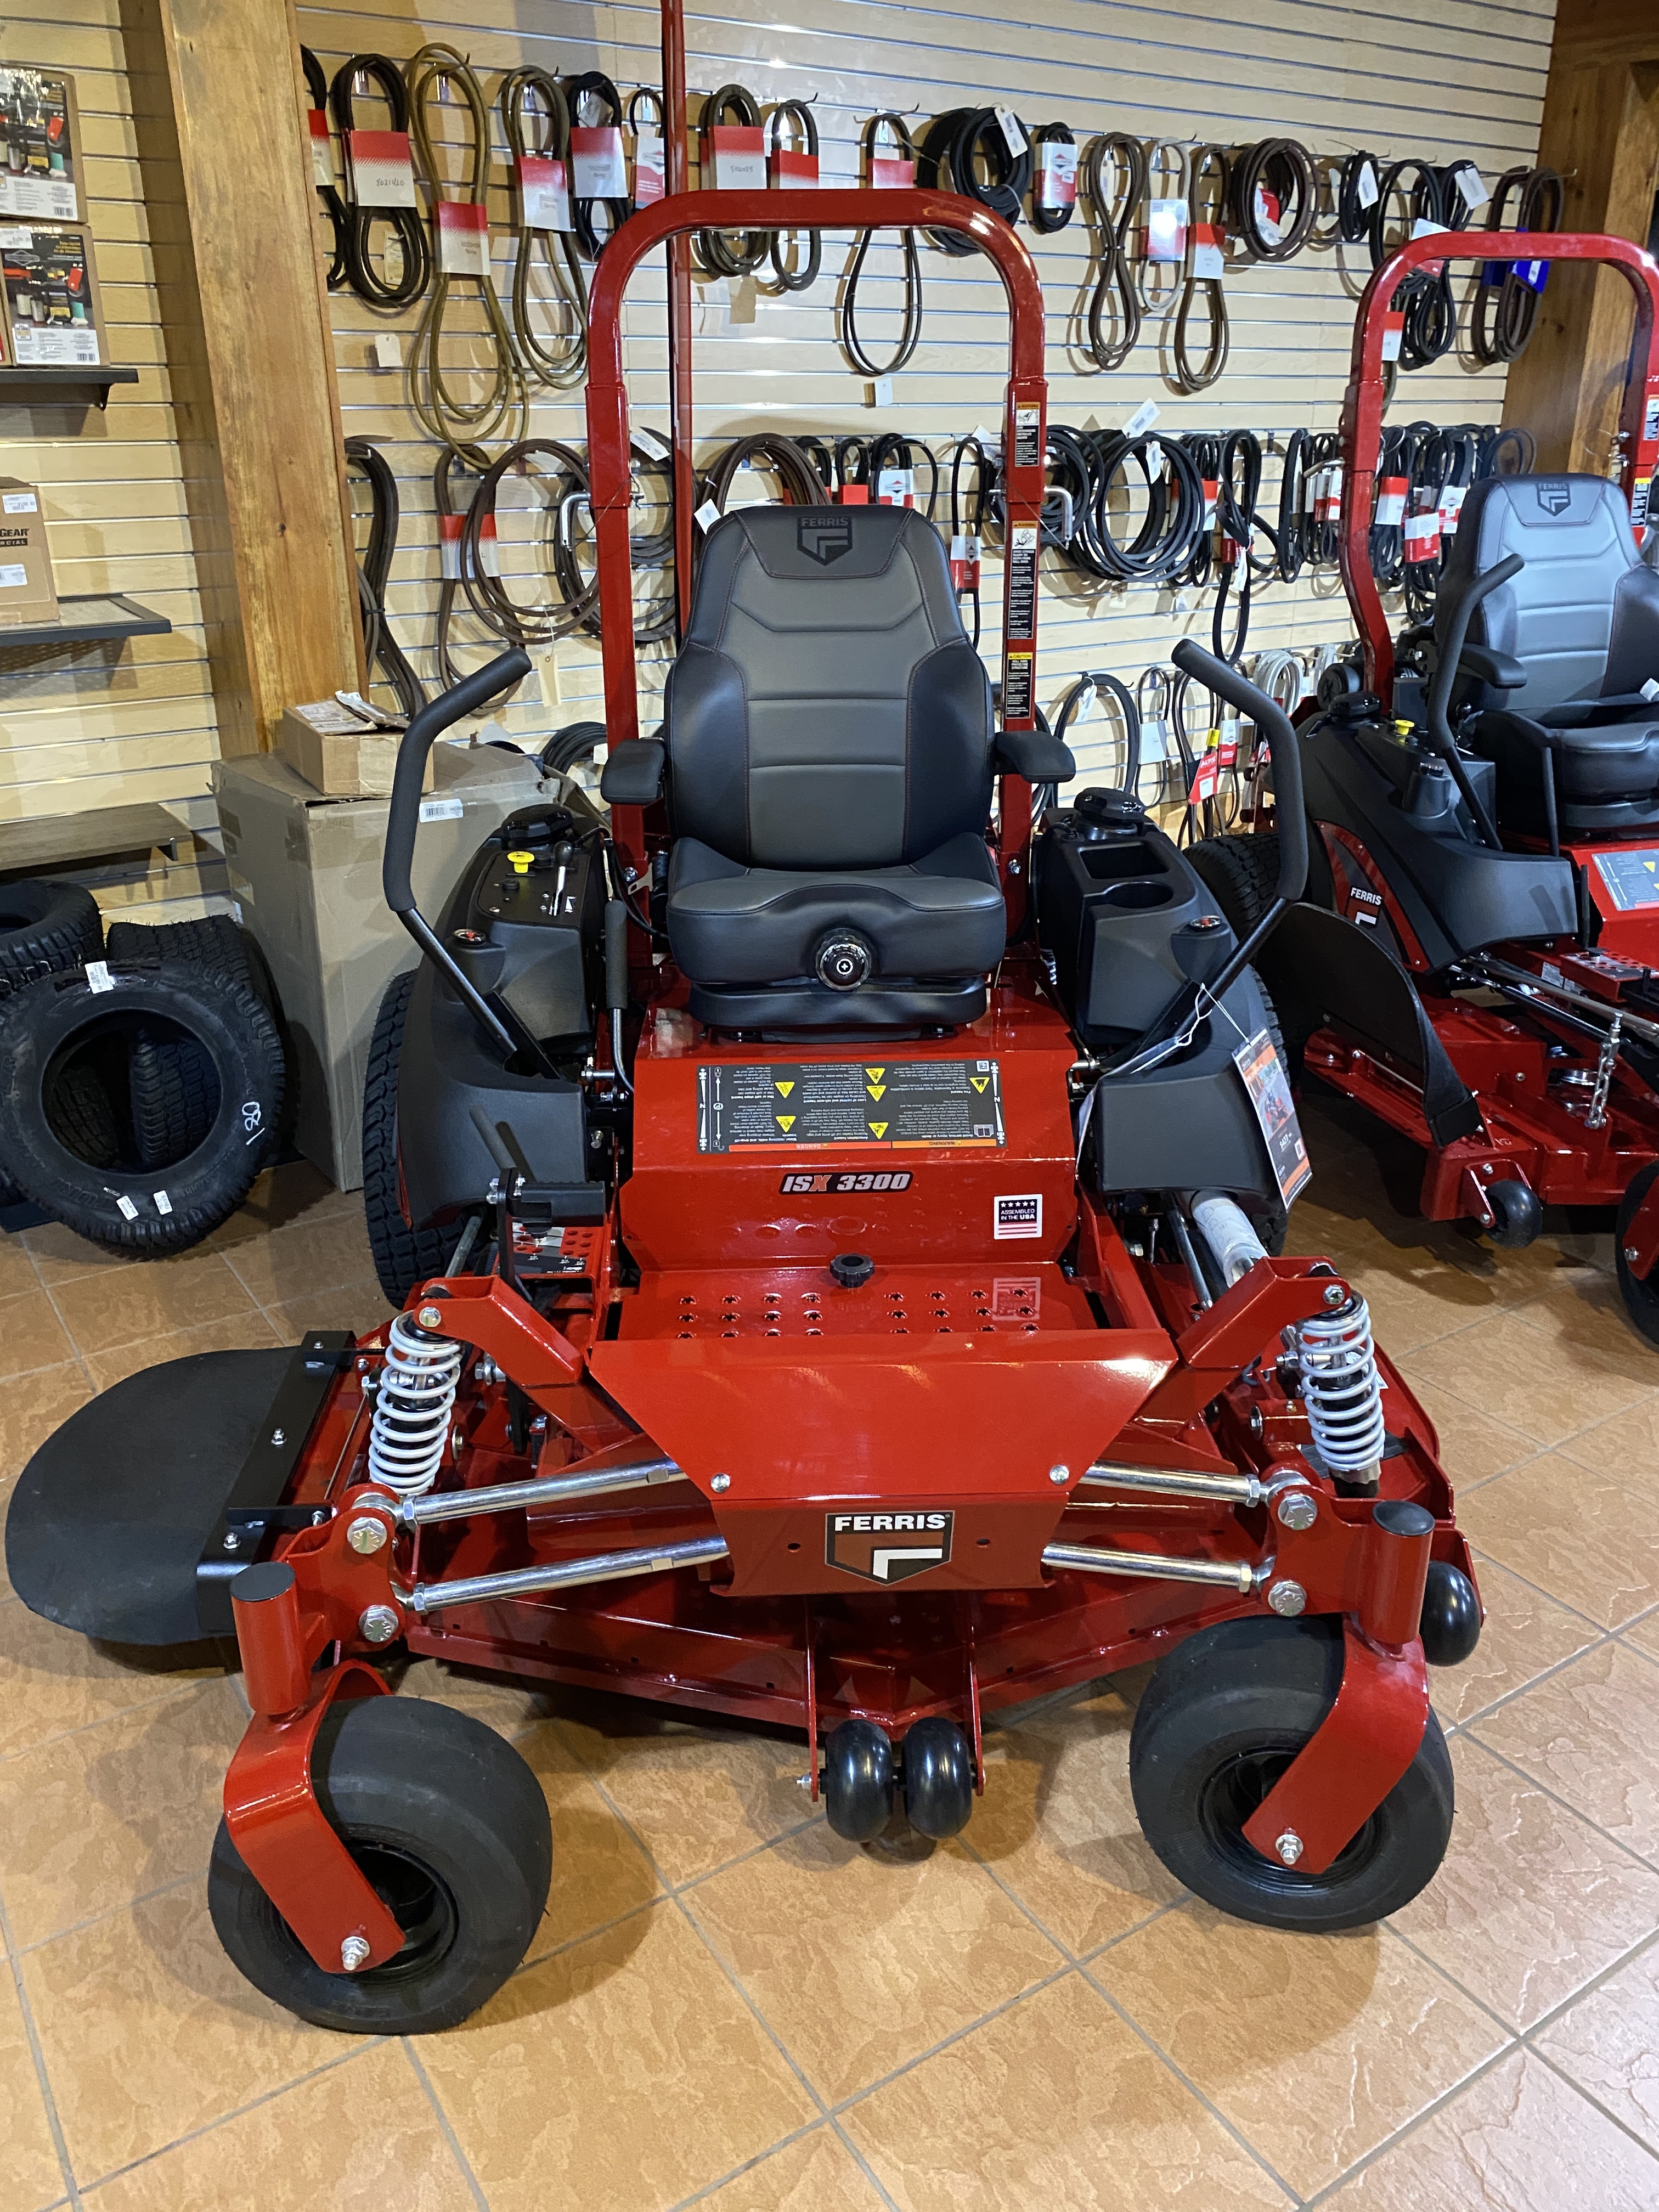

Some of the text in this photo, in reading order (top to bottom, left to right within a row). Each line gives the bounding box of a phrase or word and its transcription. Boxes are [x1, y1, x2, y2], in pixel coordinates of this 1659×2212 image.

[802, 517, 849, 527] FERRIS
[1351, 887, 1381, 905] FERRIS
[782, 1173, 910, 1192] ISX 3300
[834, 1514, 946, 1531] FERRIS
